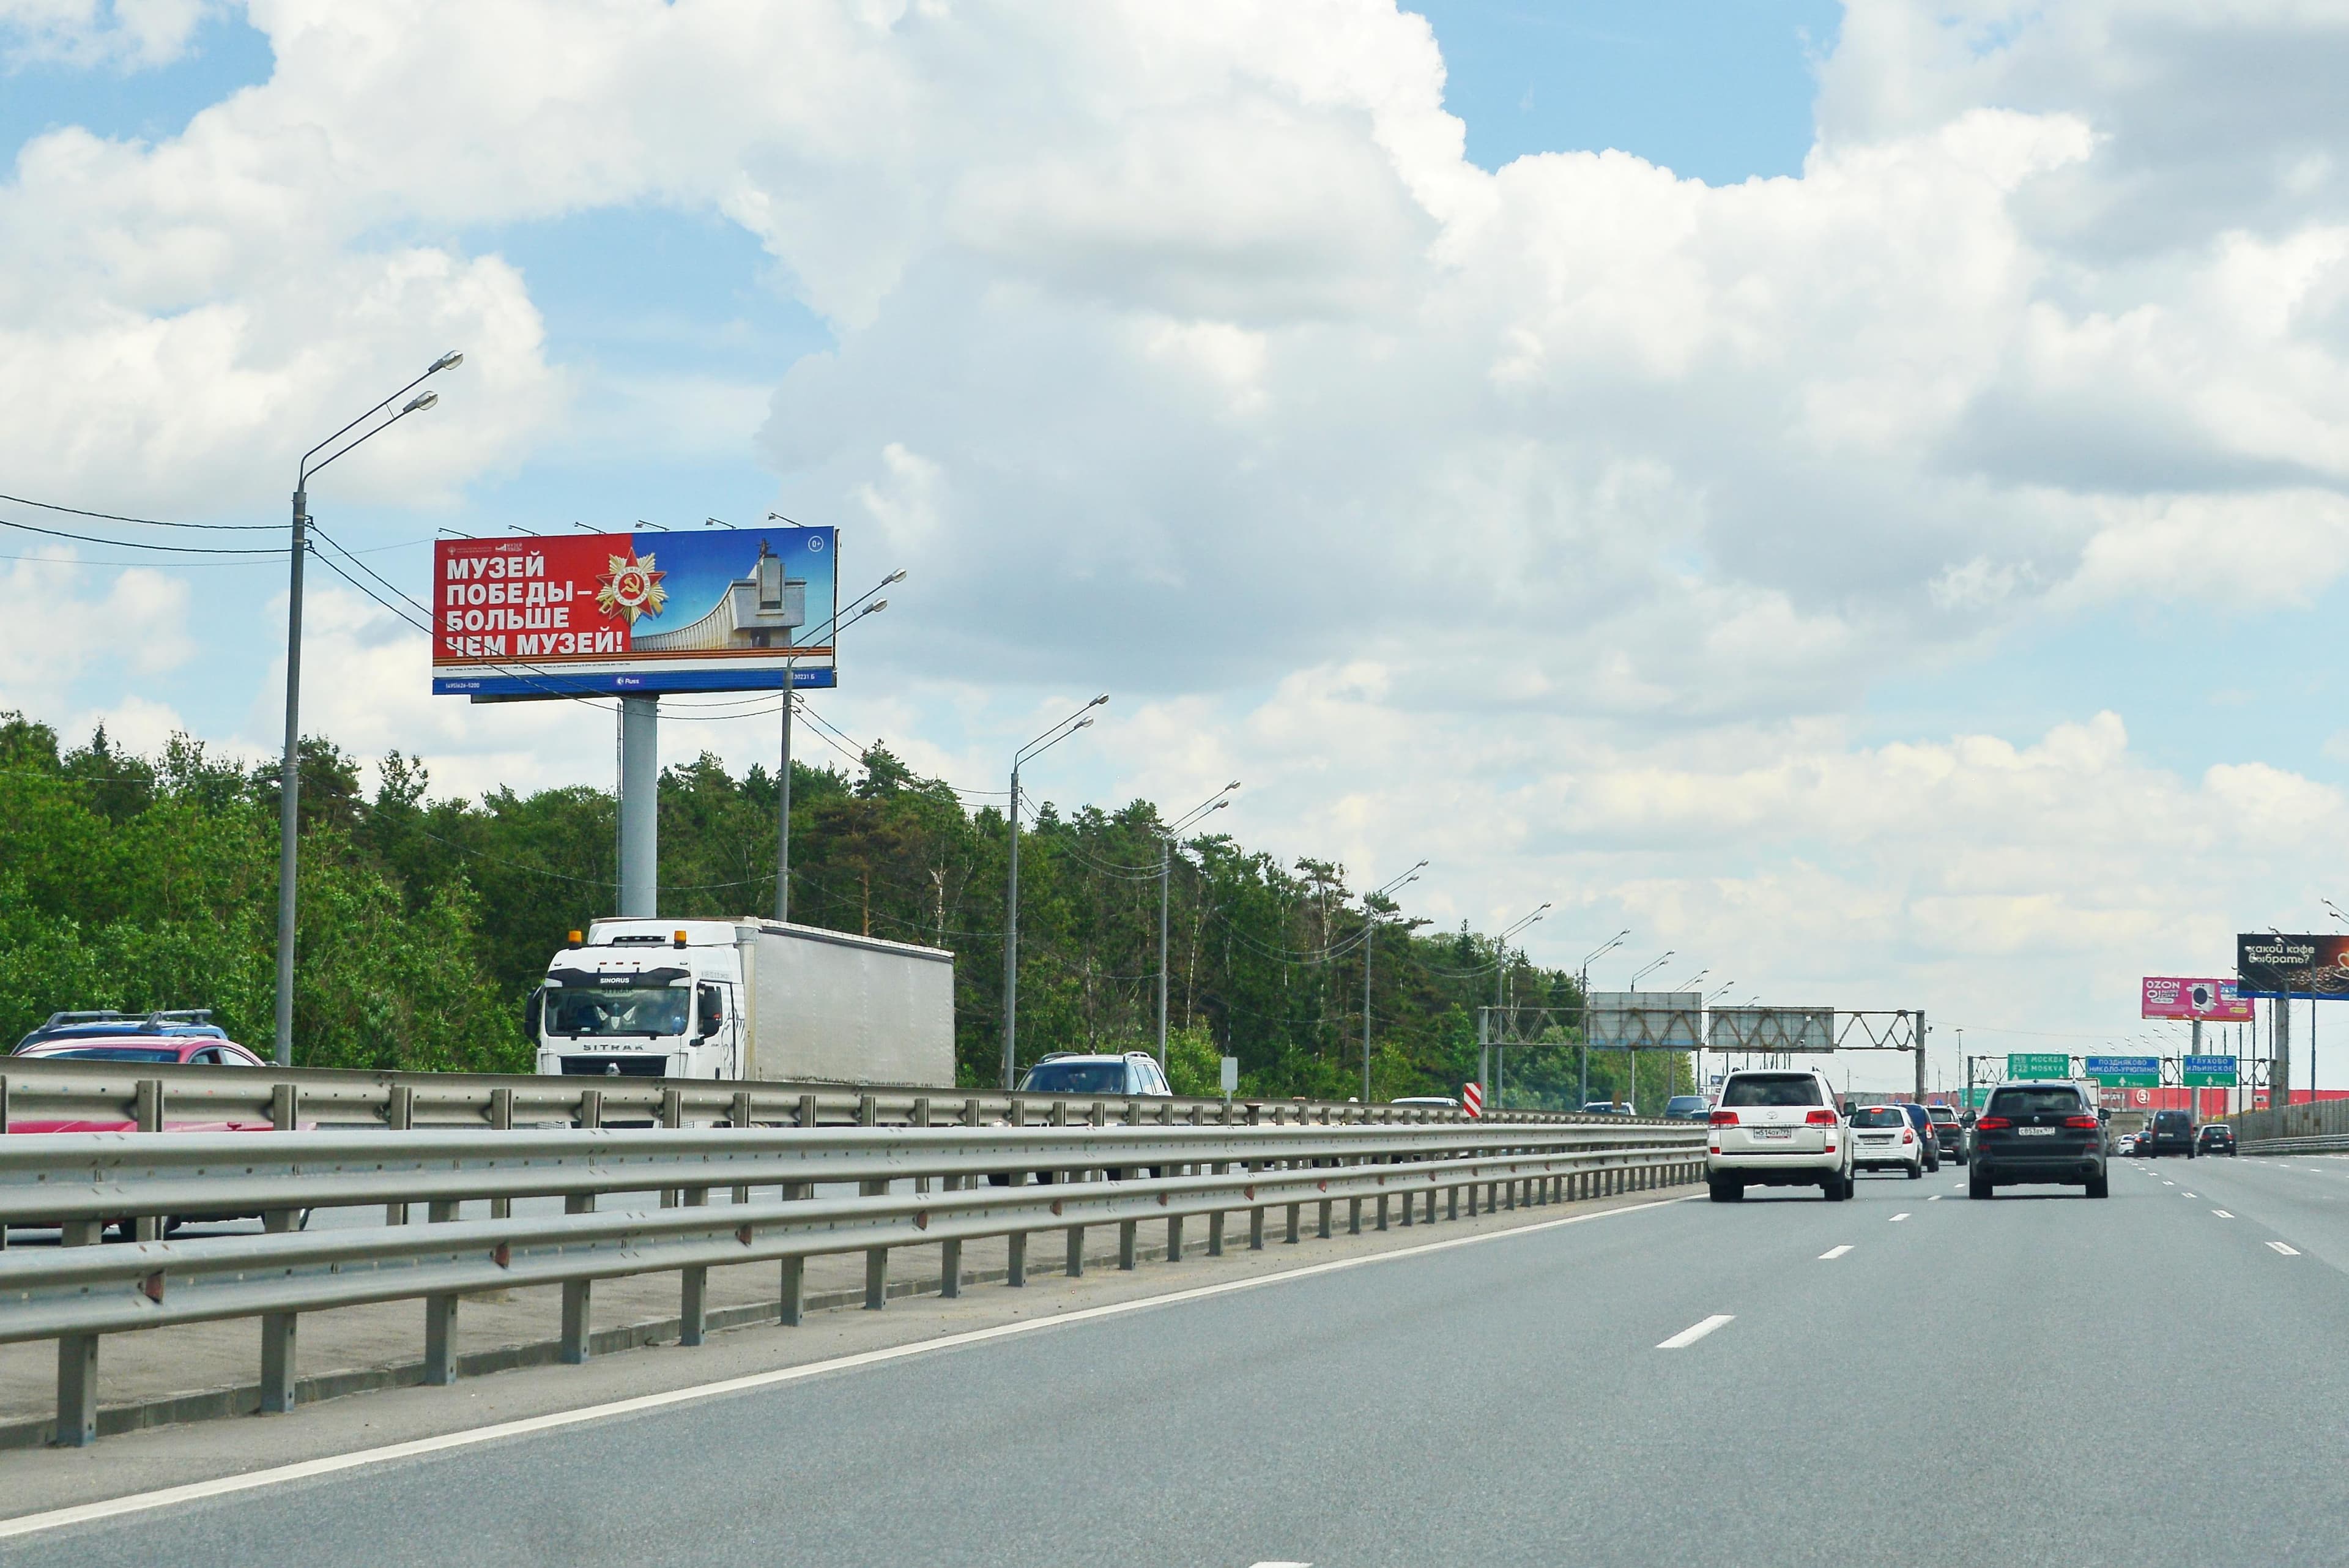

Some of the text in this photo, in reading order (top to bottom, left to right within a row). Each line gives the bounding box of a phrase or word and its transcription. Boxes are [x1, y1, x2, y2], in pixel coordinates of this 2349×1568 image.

[447, 550, 544, 580] МУЗЕЙ
[447, 607, 570, 632] БОЛЬШЕ
[447, 626, 623, 657] ЧЕМ МУЗЕЙ!
[2248, 953, 2310, 965] выбрать?
[2249, 944, 2315, 955] какой кофе
